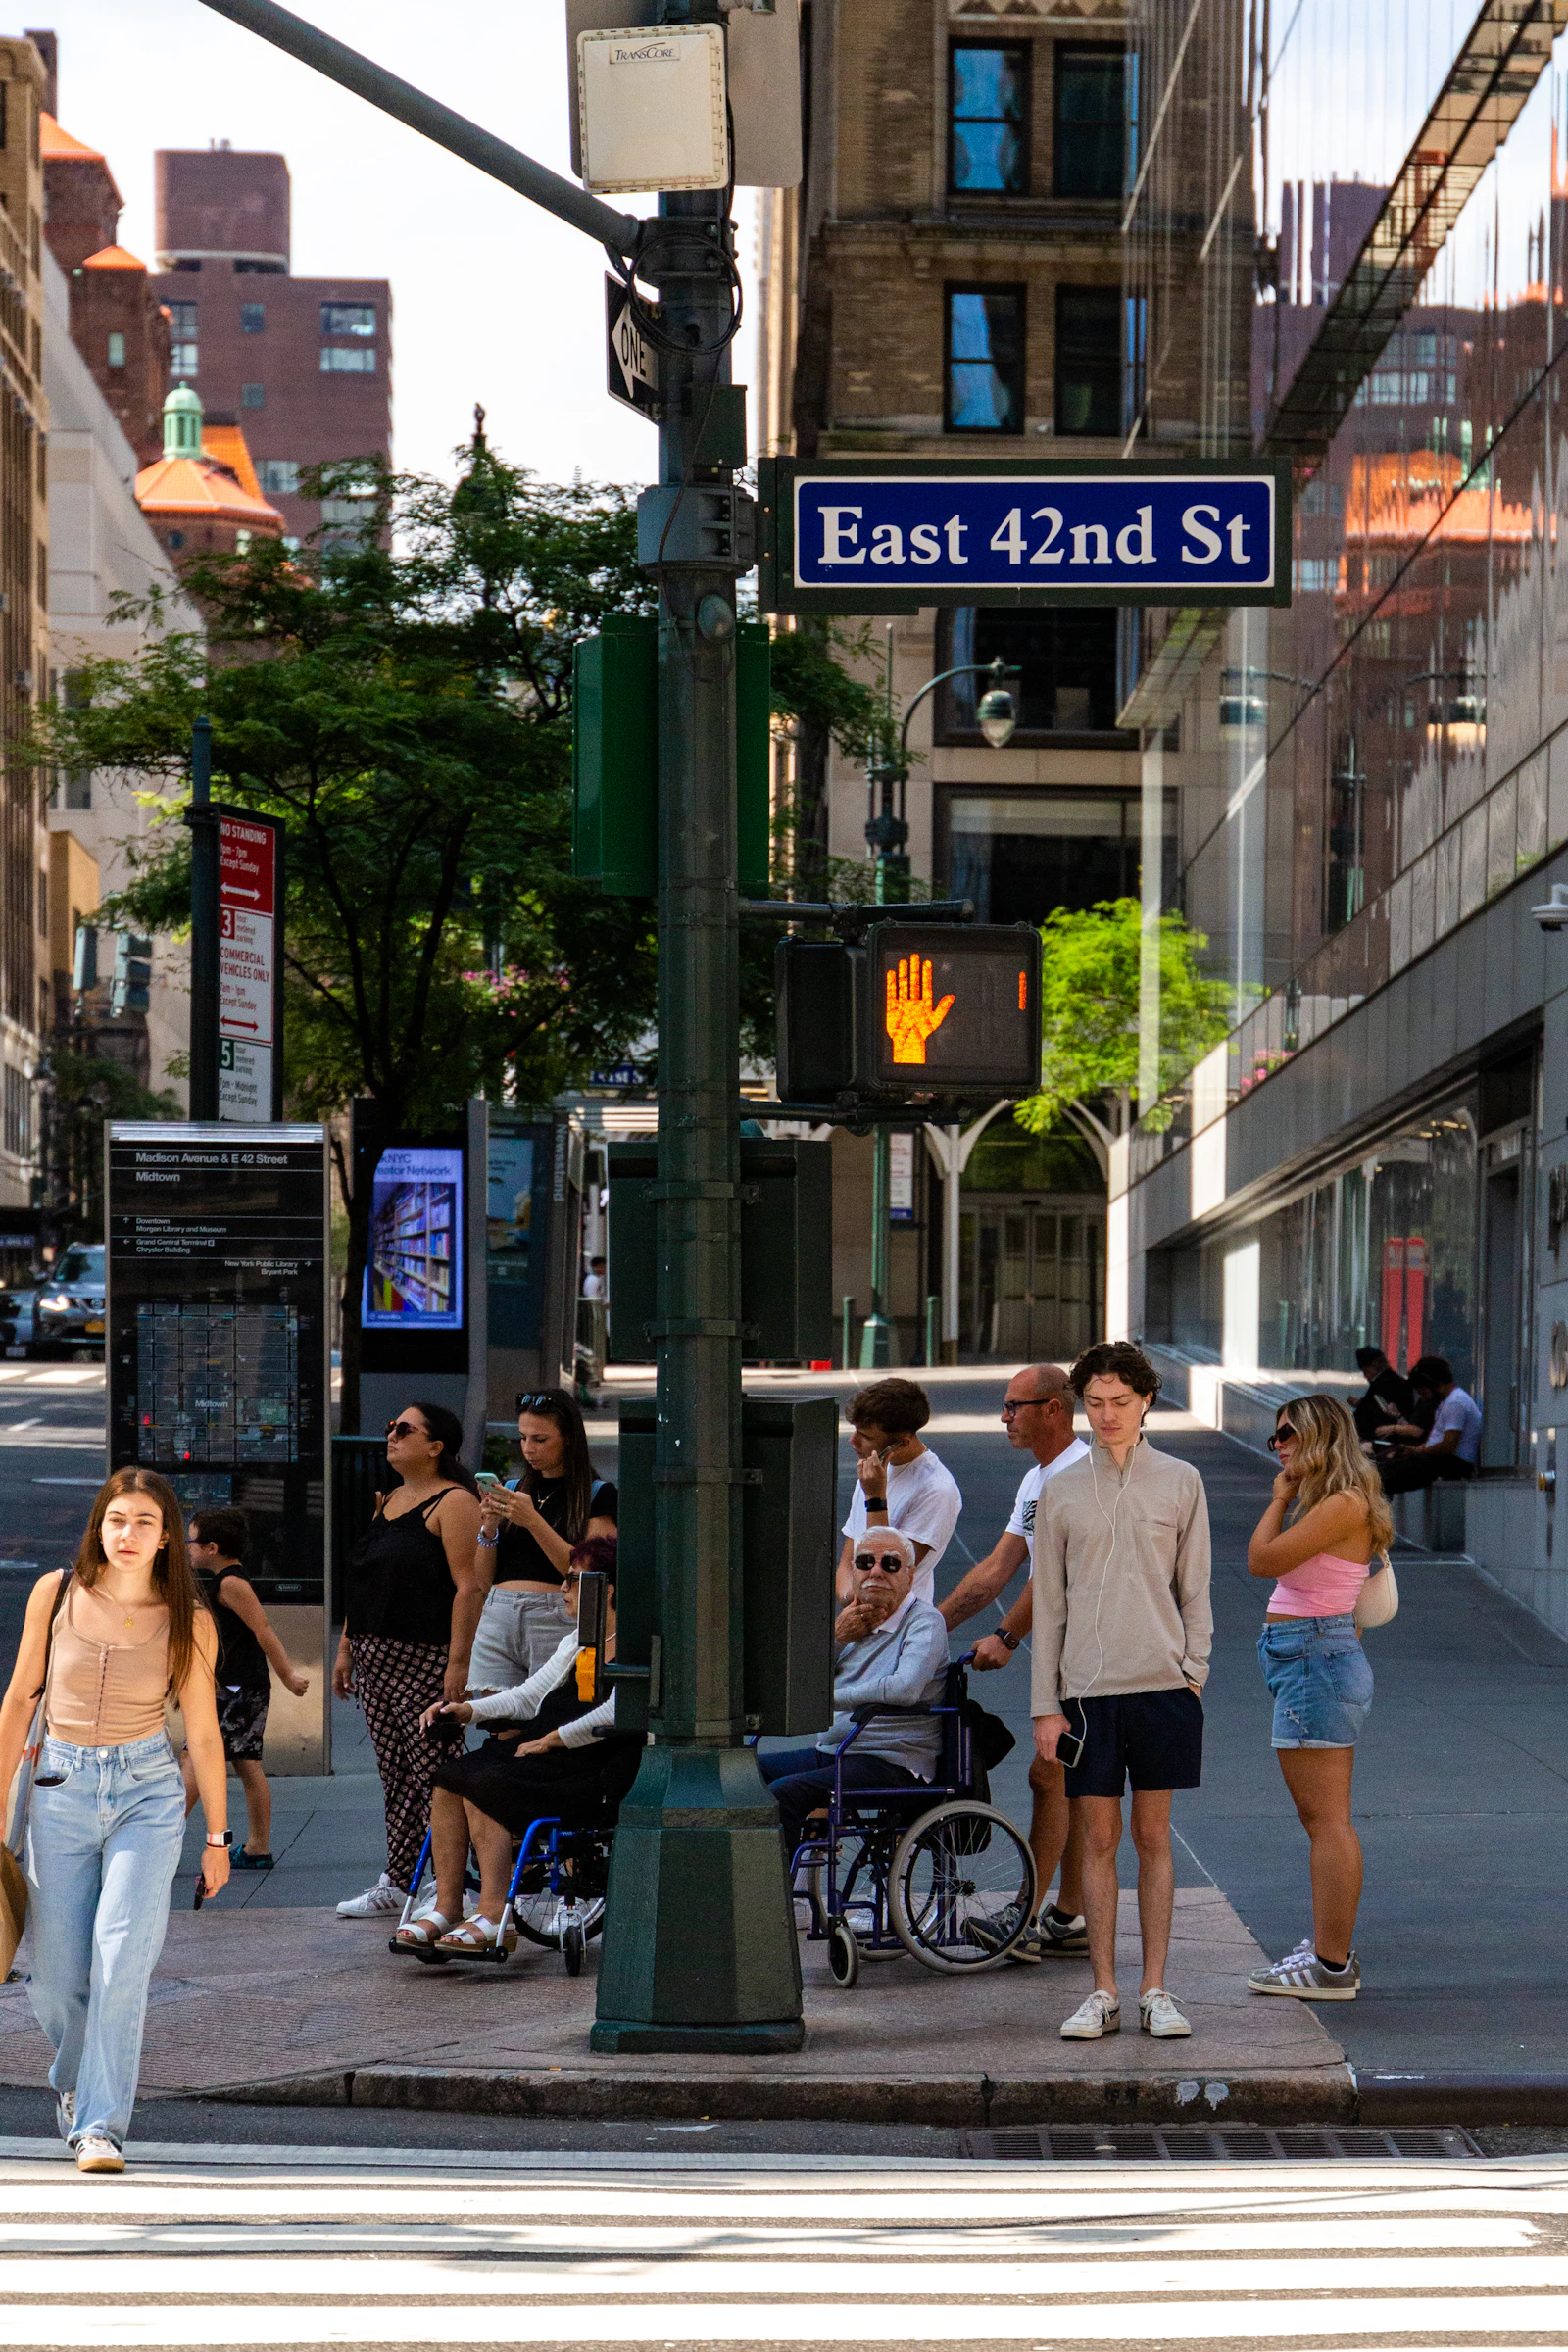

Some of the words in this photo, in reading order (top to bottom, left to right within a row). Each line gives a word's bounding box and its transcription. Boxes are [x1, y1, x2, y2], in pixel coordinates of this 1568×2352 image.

[621, 321, 647, 377] ONE
[817, 506, 969, 565] East
[990, 504, 1157, 565] 42nd
[1181, 504, 1251, 565] St
[220, 823, 230, 836] NO
[232, 826, 267, 845] STANDING
[220, 856, 238, 870] Except
[239, 860, 259, 875] Sunday
[222, 909, 231, 937] 3
[236, 924, 256, 935] metered
[236, 935, 253, 946] parking
[220, 946, 265, 966] COMMERCIAL
[220, 962, 251, 979] VEHICLES
[253, 969, 270, 982] ONLY
[220, 995, 237, 1007] Except
[238, 999, 257, 1012] Sunday
[221, 1041, 230, 1067] 5
[235, 1080, 257, 1094] Midnight
[220, 1090, 236, 1104] Except
[237, 1093, 257, 1106] Sunday
[135, 1152, 179, 1163] Madison
[181, 1153, 219, 1163] Avenue
[220, 1153, 229, 1163] &
[231, 1154, 239, 1164] E
[241, 1154, 254, 1164] 42
[256, 1154, 288, 1164] Street
[135, 1172, 180, 1182] Midtown
[407, 1165, 451, 1175] Network
[136, 1225, 161, 1234] Morgan
[195, 1399, 228, 1408] Midtown
